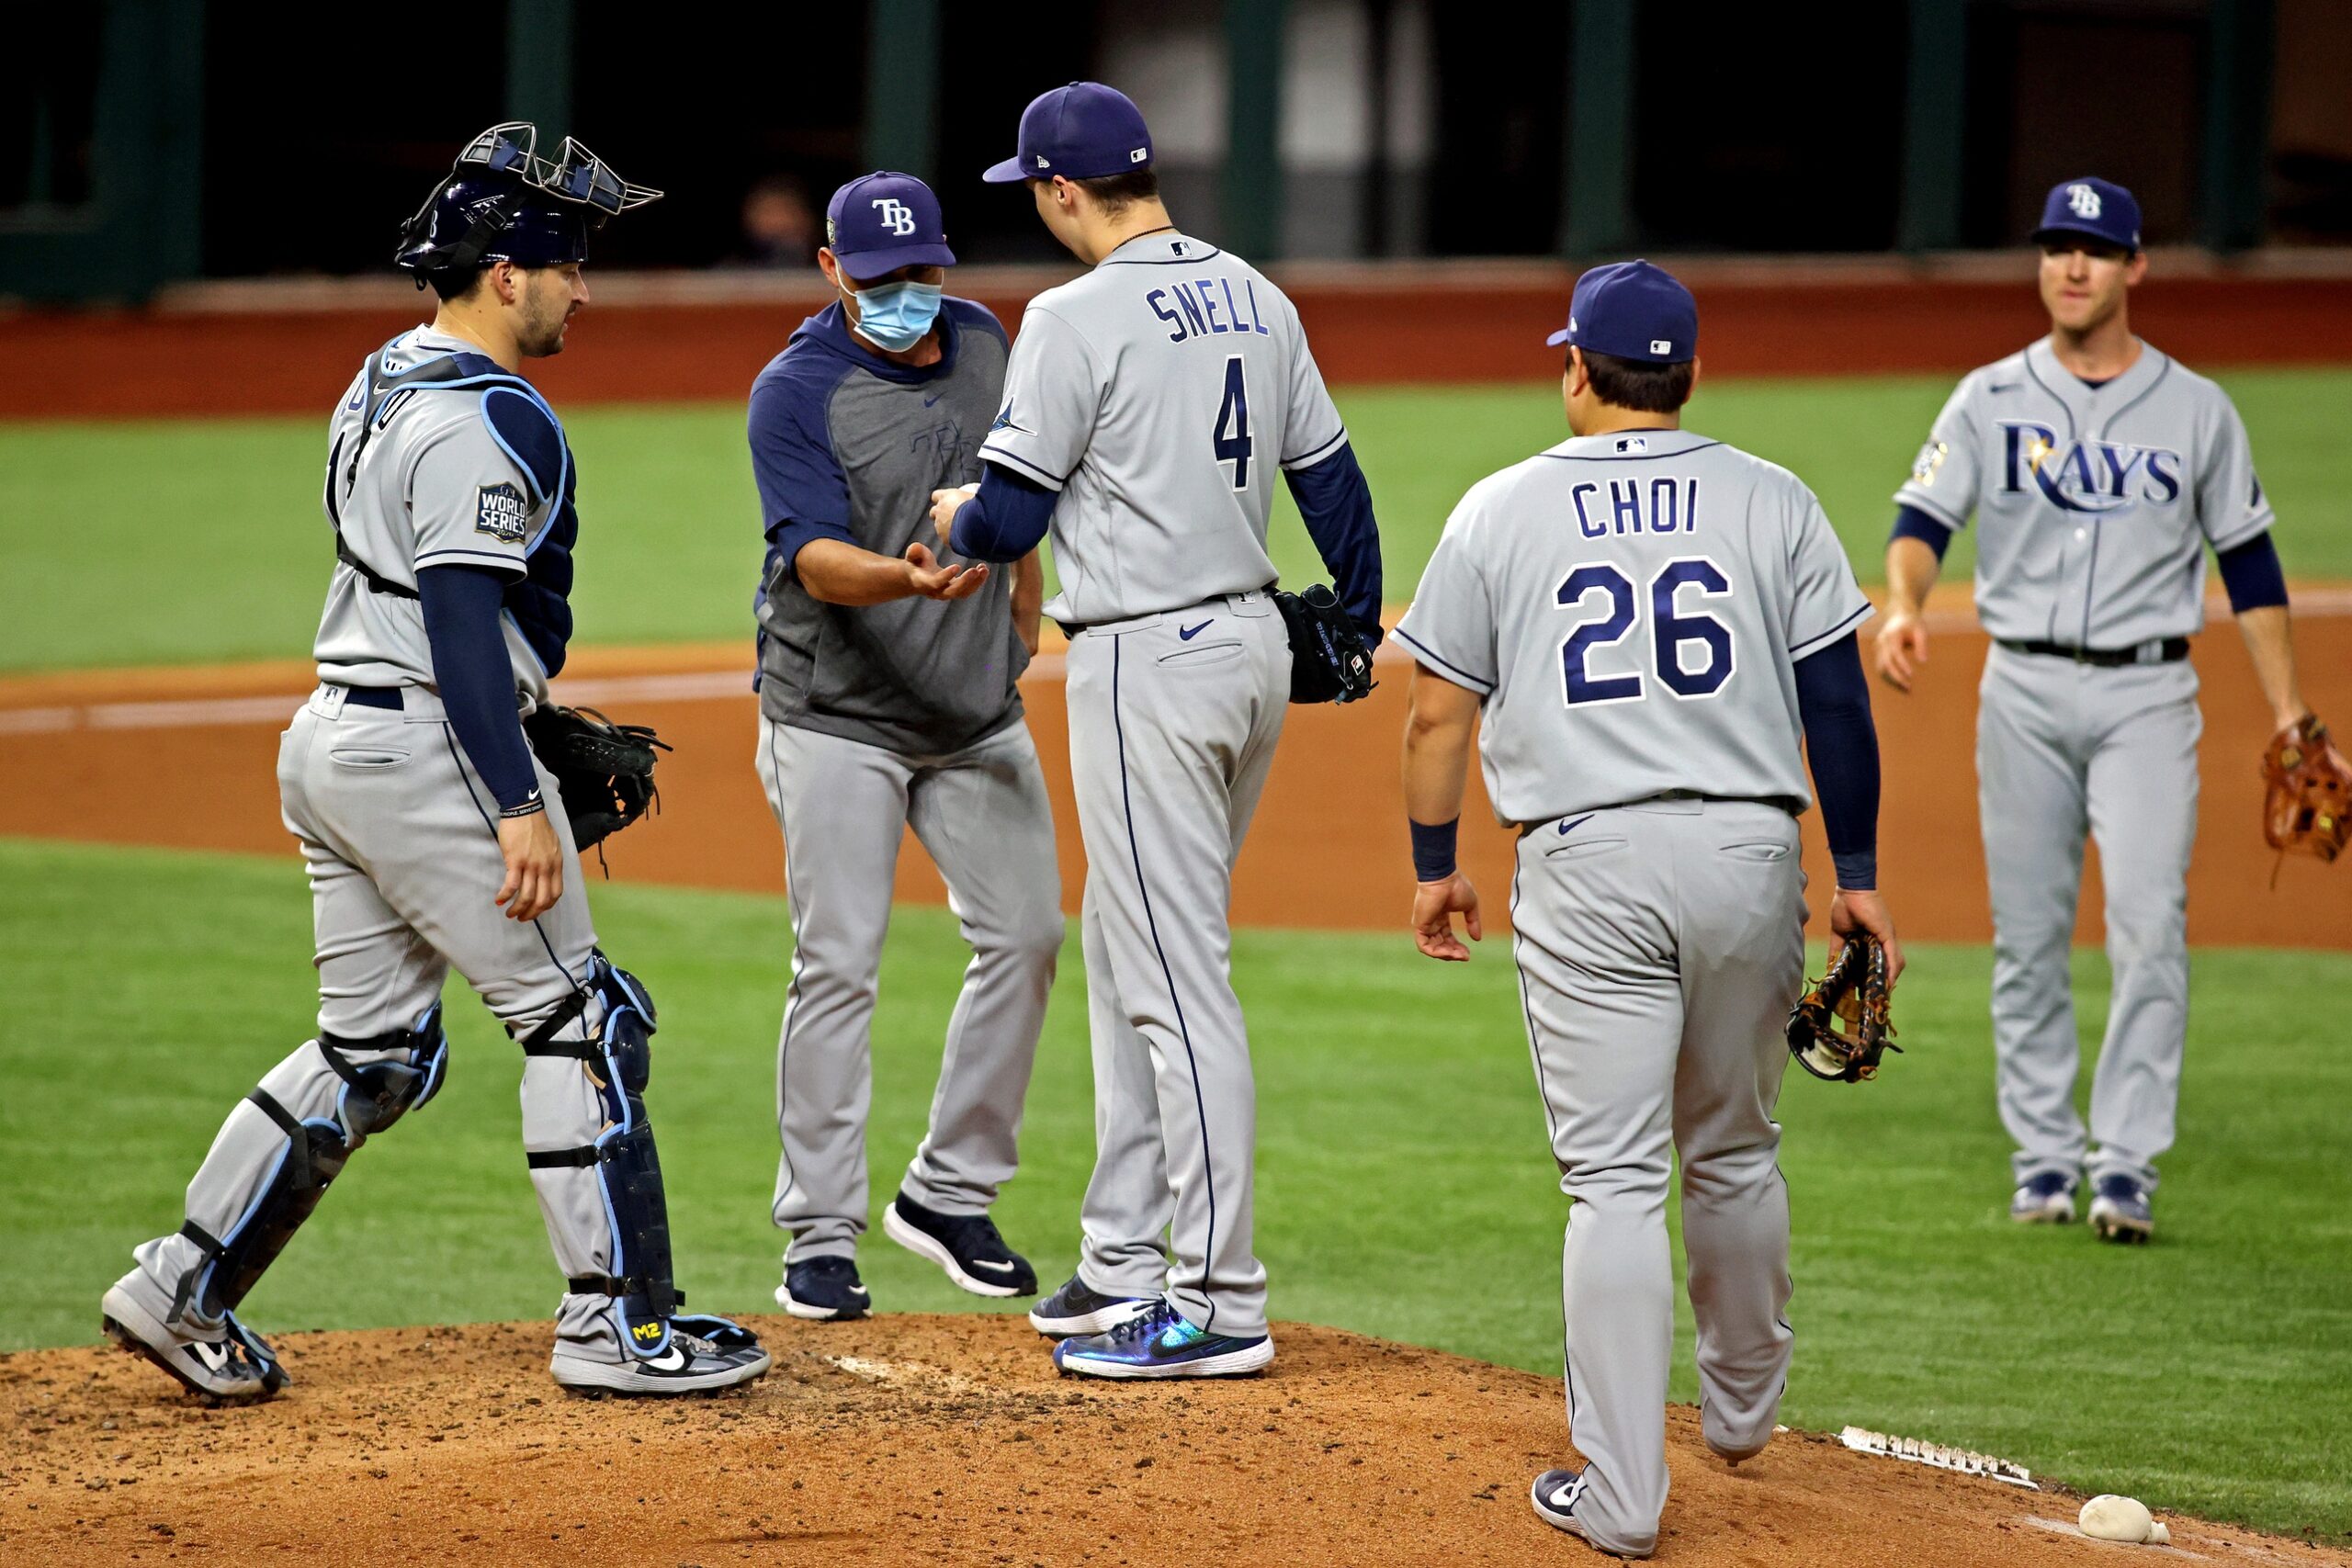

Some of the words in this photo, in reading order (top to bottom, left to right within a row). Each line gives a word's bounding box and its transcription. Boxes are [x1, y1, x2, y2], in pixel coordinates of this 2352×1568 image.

[872, 198, 917, 237] TB
[2066, 185, 2101, 220] TB
[1146, 276, 1270, 344] SNELL
[1213, 353, 1254, 492] 4
[1995, 418, 2183, 513] RAYS
[480, 509, 526, 536] SERIES
[481, 492, 526, 519] WORLD
[1571, 475, 1700, 542] CHOI
[1551, 554, 1737, 709] 26
[632, 1322, 662, 1341] M2
